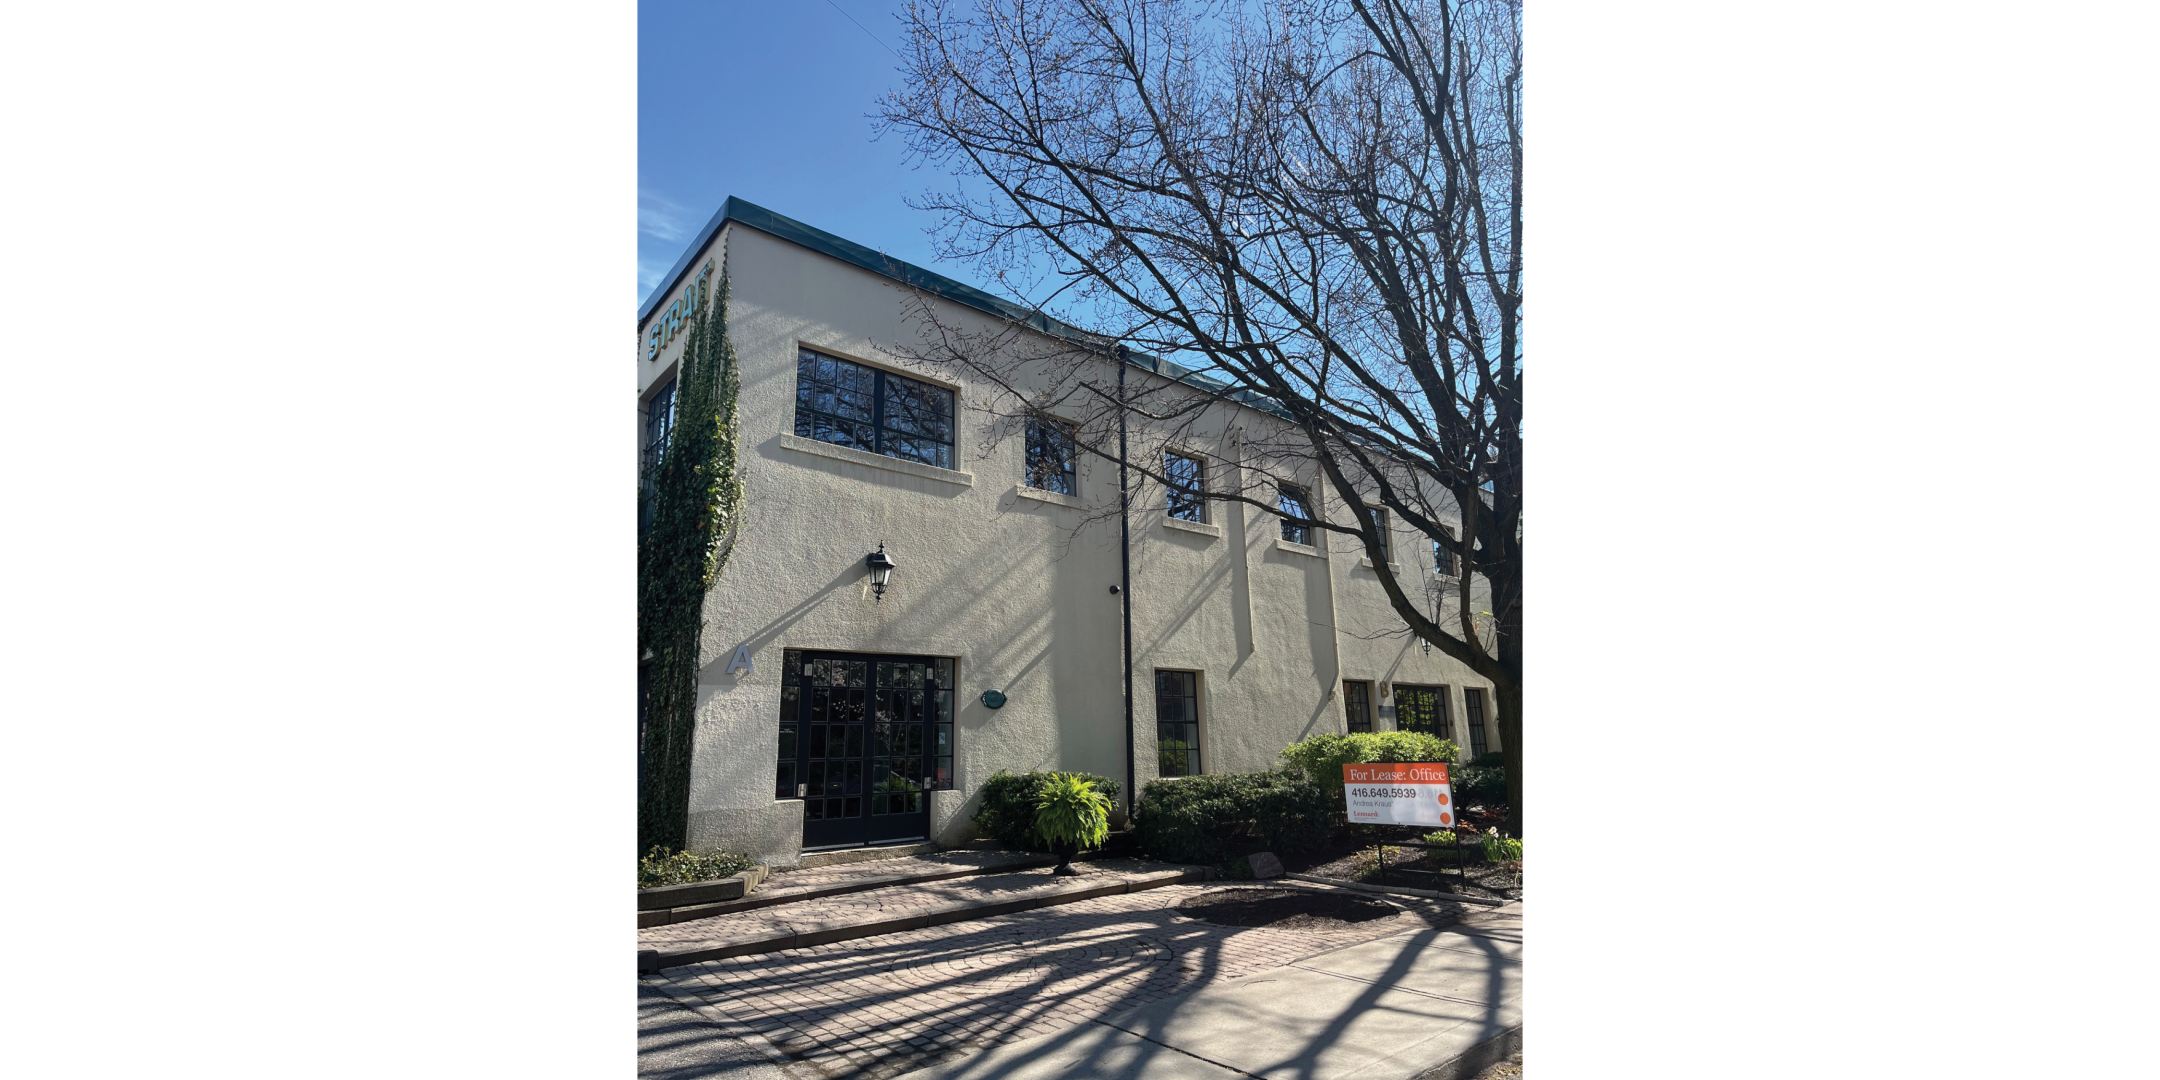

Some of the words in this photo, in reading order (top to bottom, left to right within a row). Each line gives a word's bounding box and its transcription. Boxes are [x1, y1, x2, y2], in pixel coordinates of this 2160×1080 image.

[726, 644, 755, 674] A
[1380, 681, 1389, 698] B
[1350, 769, 1368, 781] For
[1371, 769, 1406, 781] Lease:
[1409, 768, 1446, 781] Office
[1351, 788, 1417, 798] 416.649.5939
